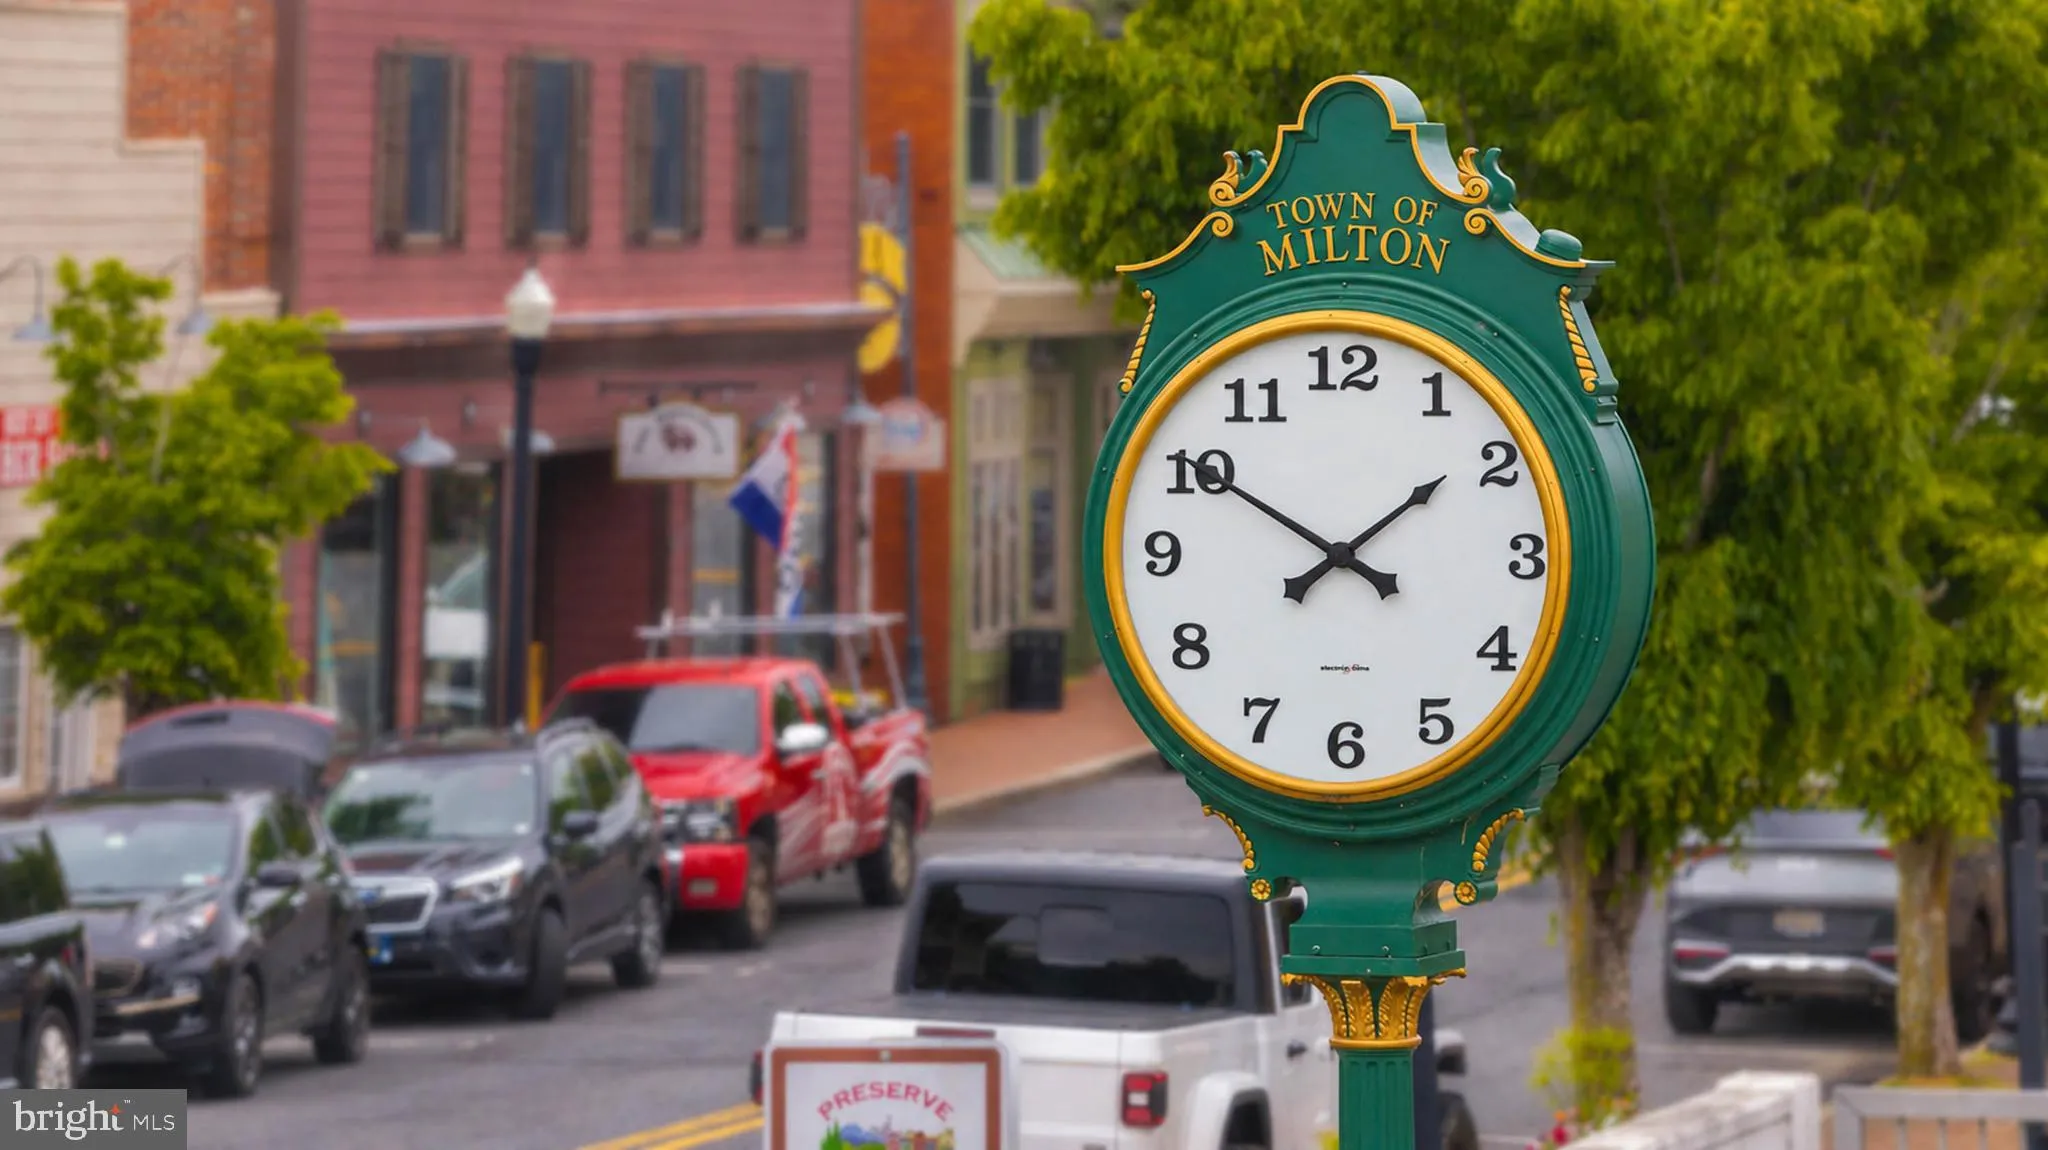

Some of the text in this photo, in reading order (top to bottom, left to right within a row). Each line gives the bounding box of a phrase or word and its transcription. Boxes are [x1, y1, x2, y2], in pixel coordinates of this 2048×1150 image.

[1266, 192, 1438, 229] TOWN OF
[1256, 224, 1451, 276] MILTON
[1307, 345, 1379, 391] 12
[1224, 378, 1288, 422] 11
[1421, 372, 1452, 416] 1
[1166, 449, 1235, 495] 10
[1479, 441, 1519, 487] 2
[1144, 531, 1182, 577] 9
[1508, 533, 1546, 580] 3
[1172, 623, 1210, 670] 8
[1476, 625, 1518, 672] 4
[1243, 697, 1281, 743] 7
[1418, 697, 1455, 745] 5
[1327, 722, 1366, 769] 6
[817, 1081, 953, 1122] PRESERVE
